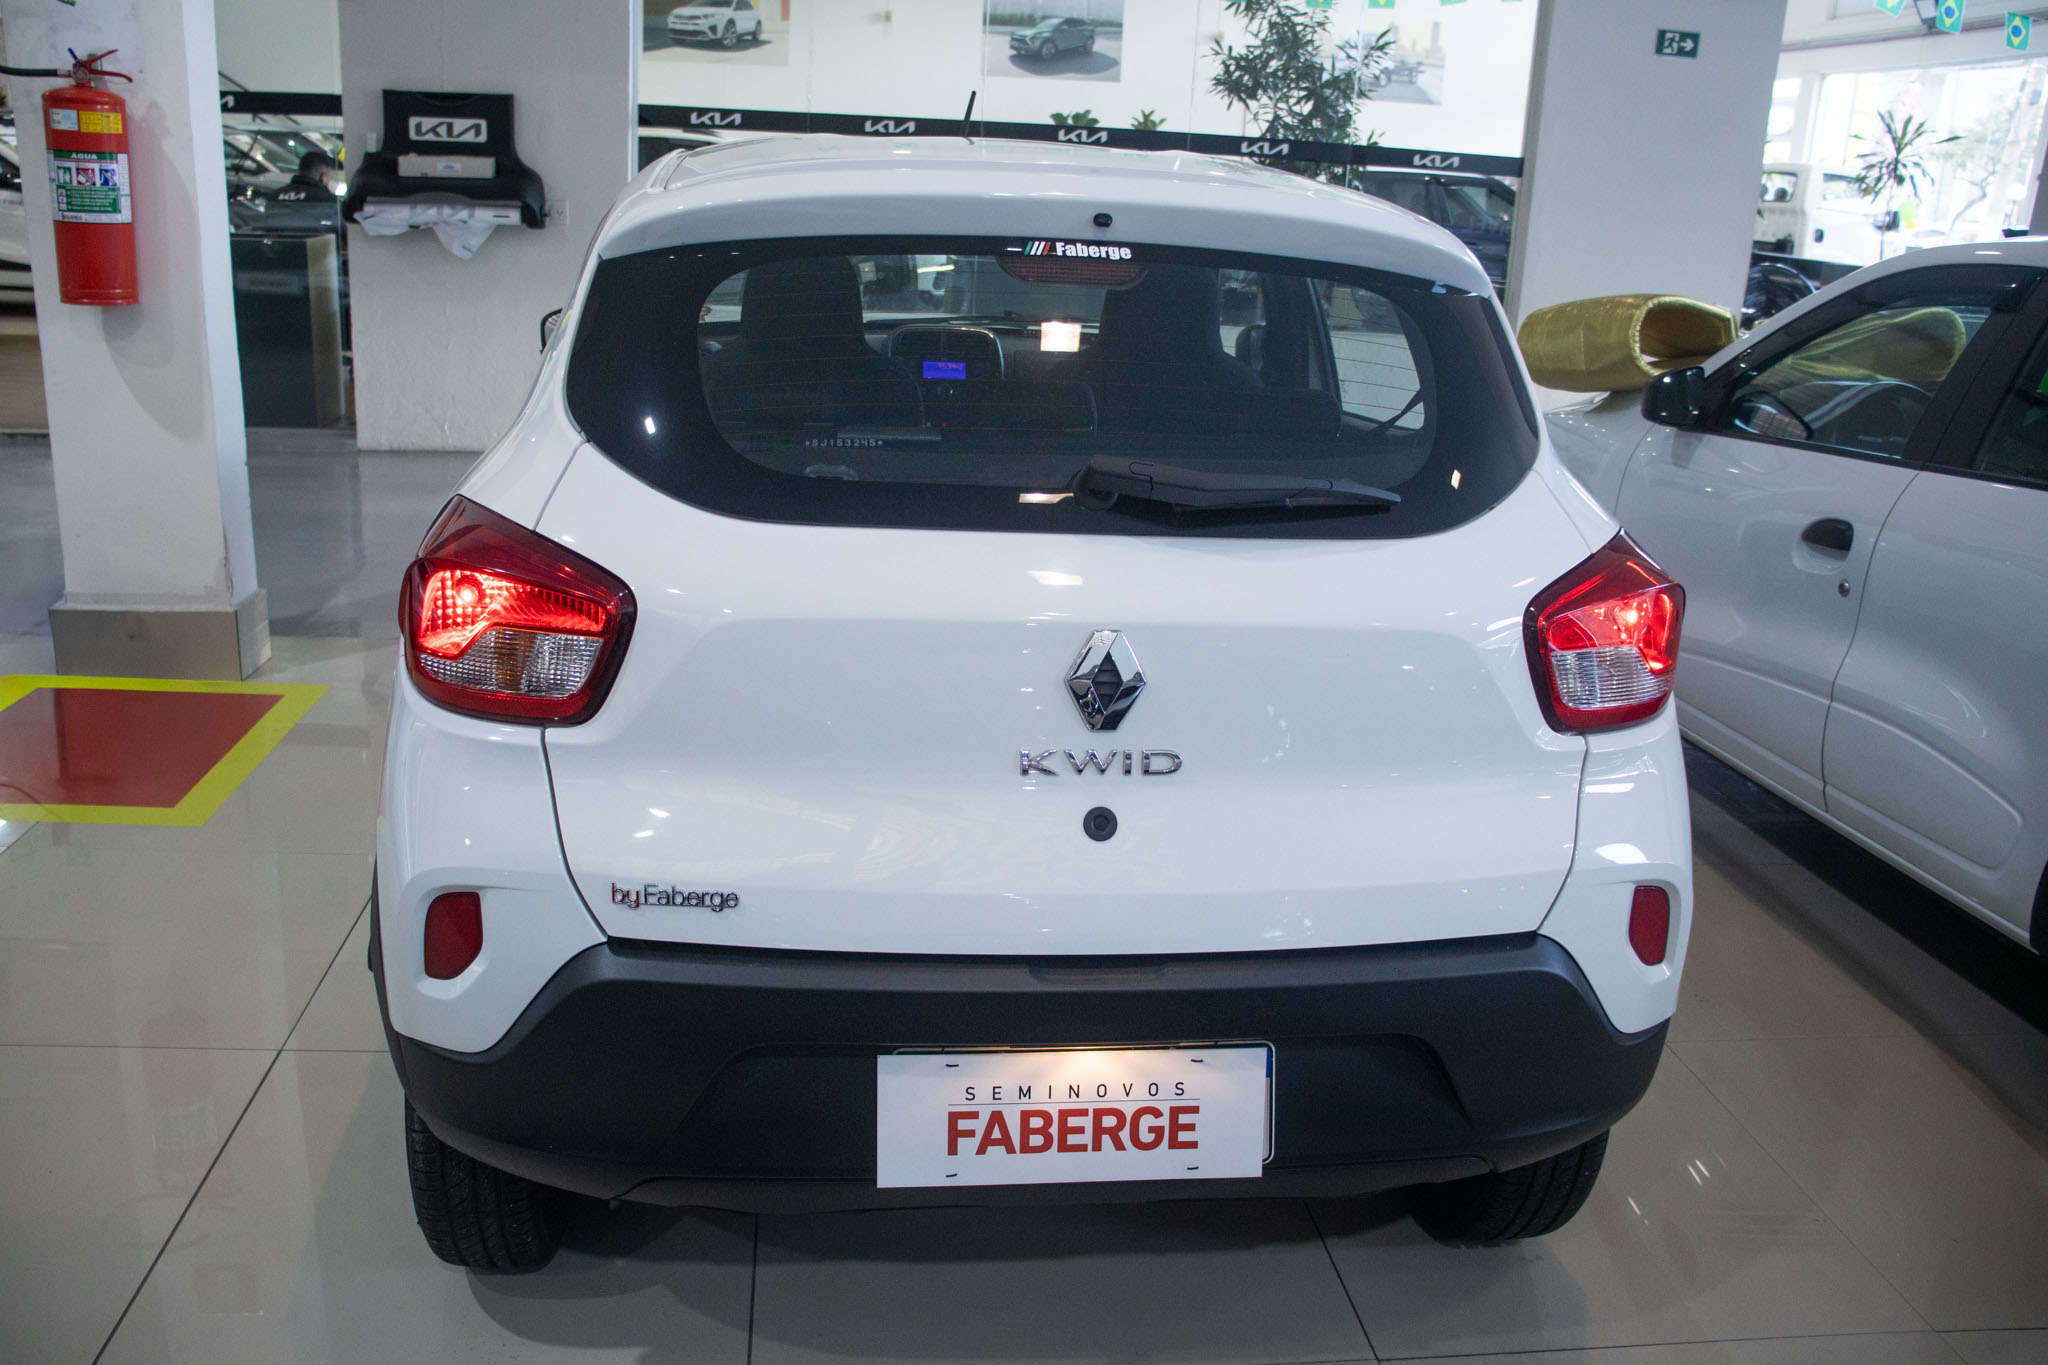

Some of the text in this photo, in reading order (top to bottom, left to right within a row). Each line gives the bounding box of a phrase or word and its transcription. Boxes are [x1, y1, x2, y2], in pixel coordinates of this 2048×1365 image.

[690, 111, 741, 126] KIA
[864, 119, 915, 134] KIA
[414, 121, 481, 139] KIA
[1058, 129, 1108, 143] KIA
[1240, 141, 1289, 156] KIA
[1412, 153, 1460, 168] KIA
[1055, 242, 1132, 261] Faberge
[1020, 749, 1183, 776] KWID
[965, 1081, 1186, 1102] SEMINOVOS
[947, 1105, 1200, 1157] FABERGE
